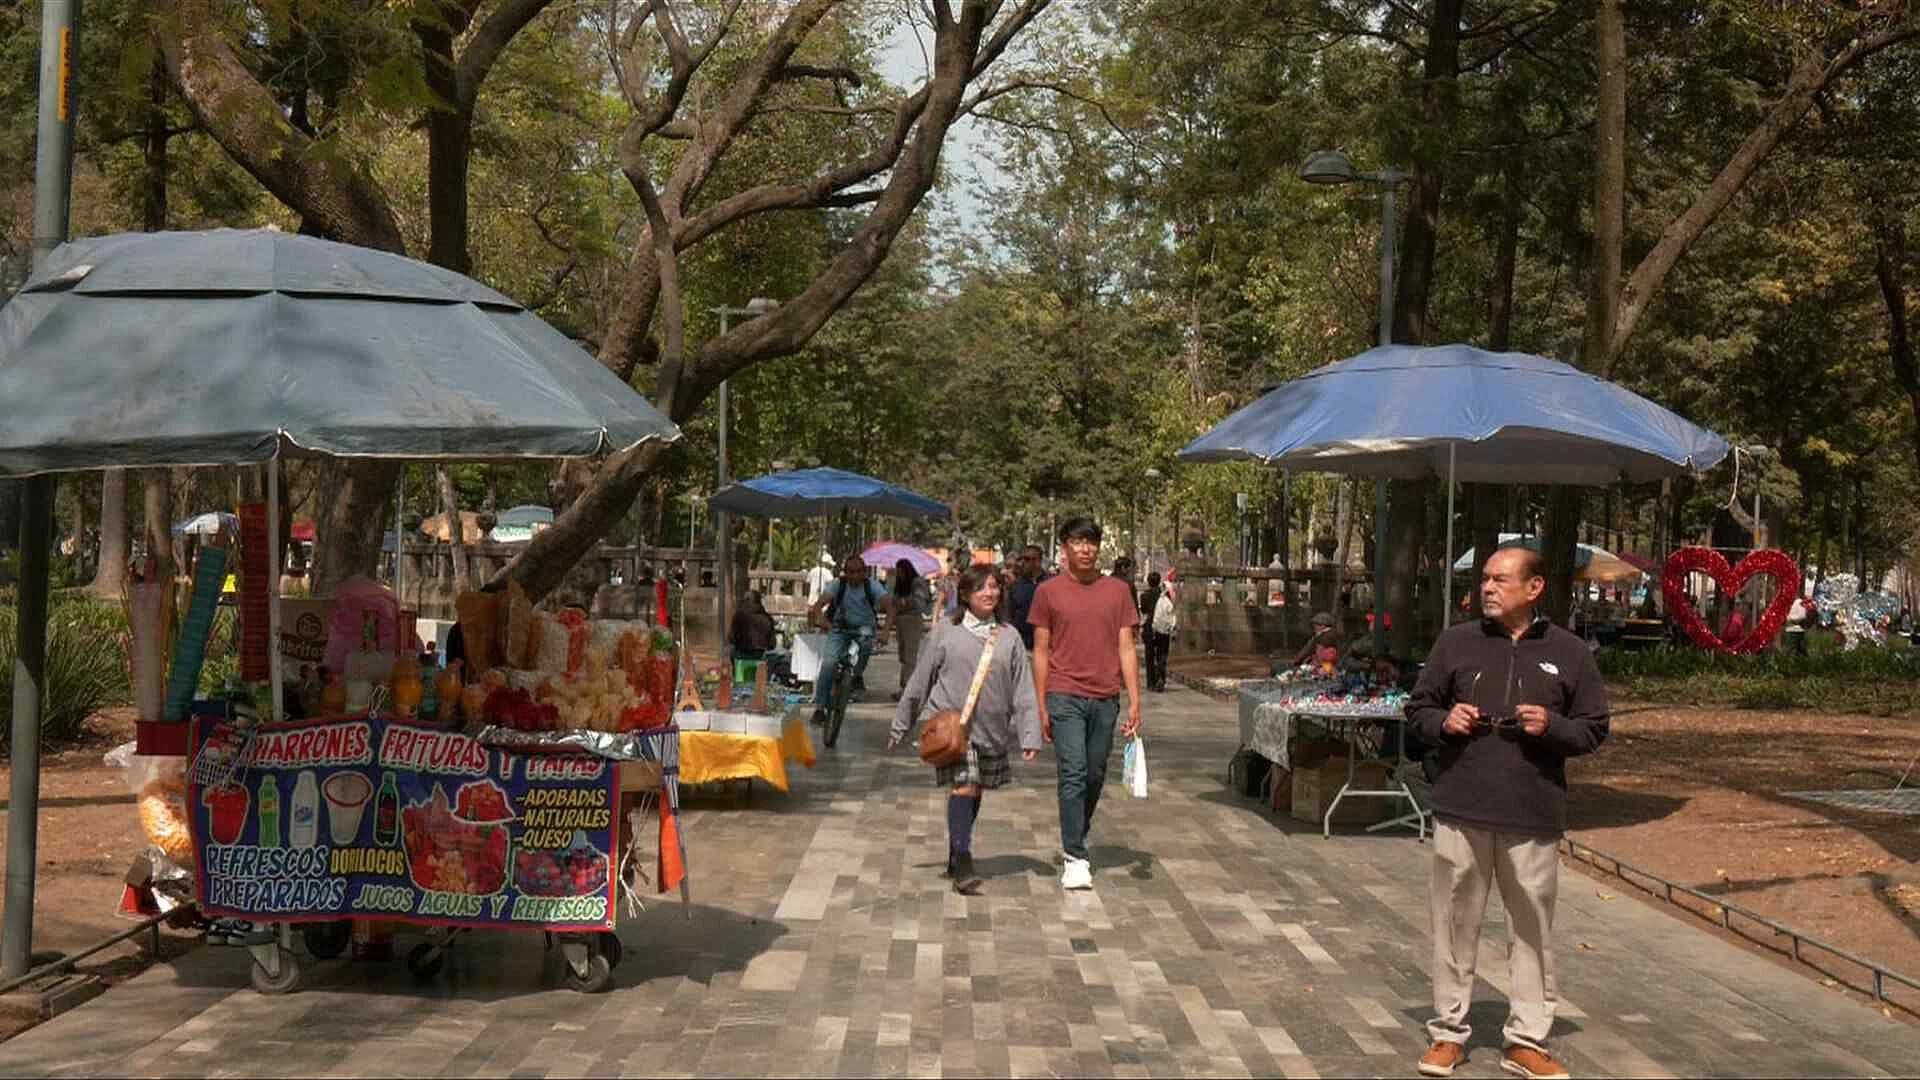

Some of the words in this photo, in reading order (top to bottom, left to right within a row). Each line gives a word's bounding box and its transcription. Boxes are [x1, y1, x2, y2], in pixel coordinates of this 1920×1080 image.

[379, 725, 490, 776] FRITURAS
[206, 845, 329, 878] REFRESCOS
[210, 876, 348, 913] PREPARADOS
[352, 883, 415, 913] JUGOS
[417, 890, 483, 916] AGUAS
[490, 894, 509, 920] Y
[511, 896, 608, 922] REFRESCOS
